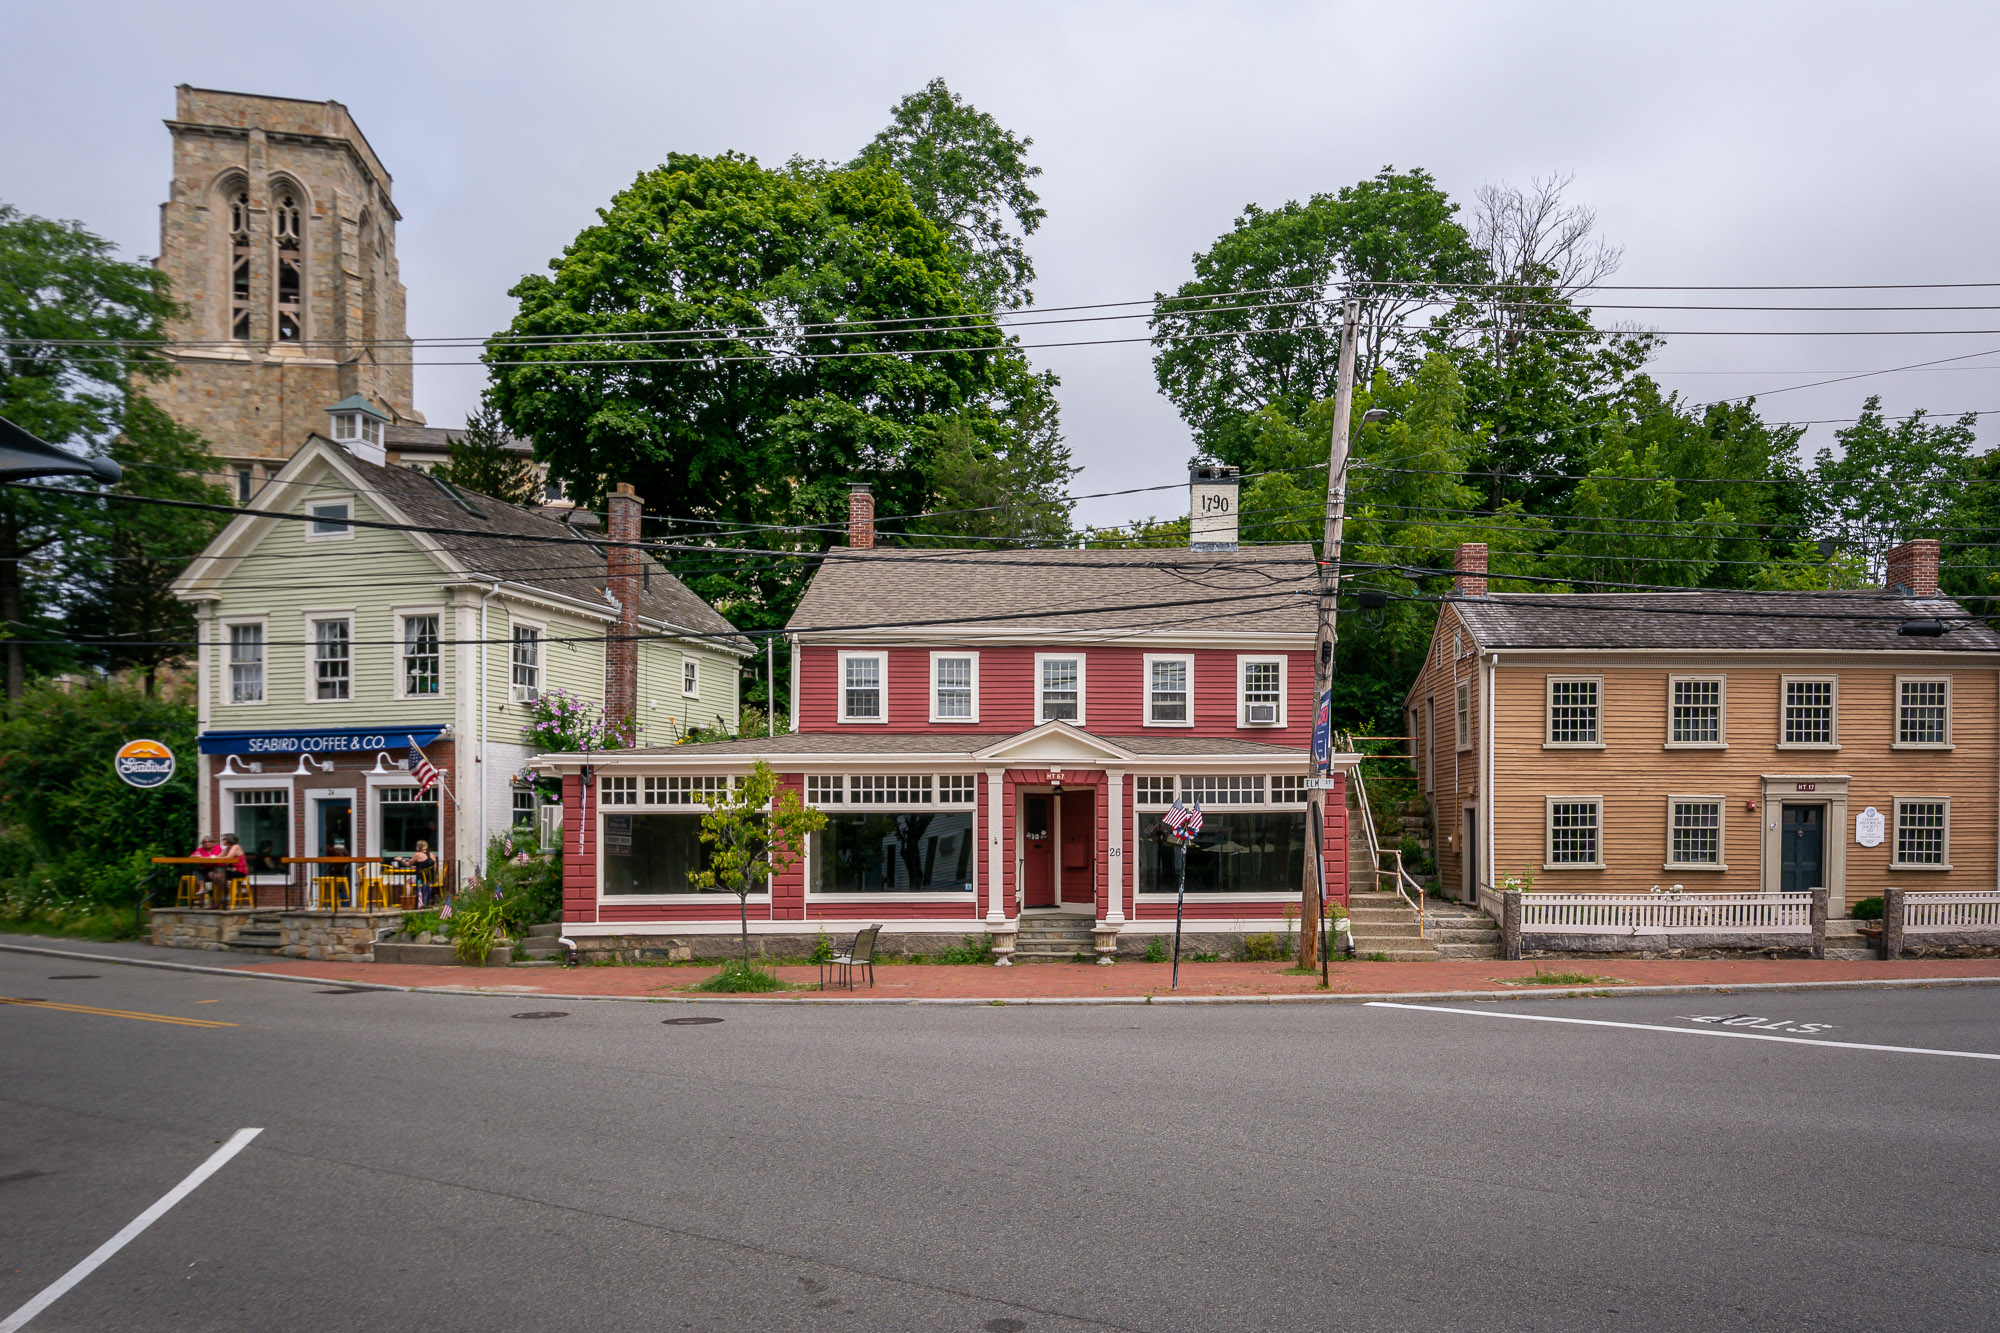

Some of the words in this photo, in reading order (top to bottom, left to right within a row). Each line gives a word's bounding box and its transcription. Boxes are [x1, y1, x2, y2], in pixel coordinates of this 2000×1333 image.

[1202, 495, 1229, 512] 1790
[249, 738, 298, 751] SEABIRD
[301, 737, 348, 751] COFFEE
[350, 736, 360, 749] &
[363, 735, 386, 749] CO.
[121, 758, 171, 774] Seabird
[1306, 779, 1320, 788] ELM
[1109, 848, 1121, 857] 26
[1690, 1014, 1833, 1033] STOP
